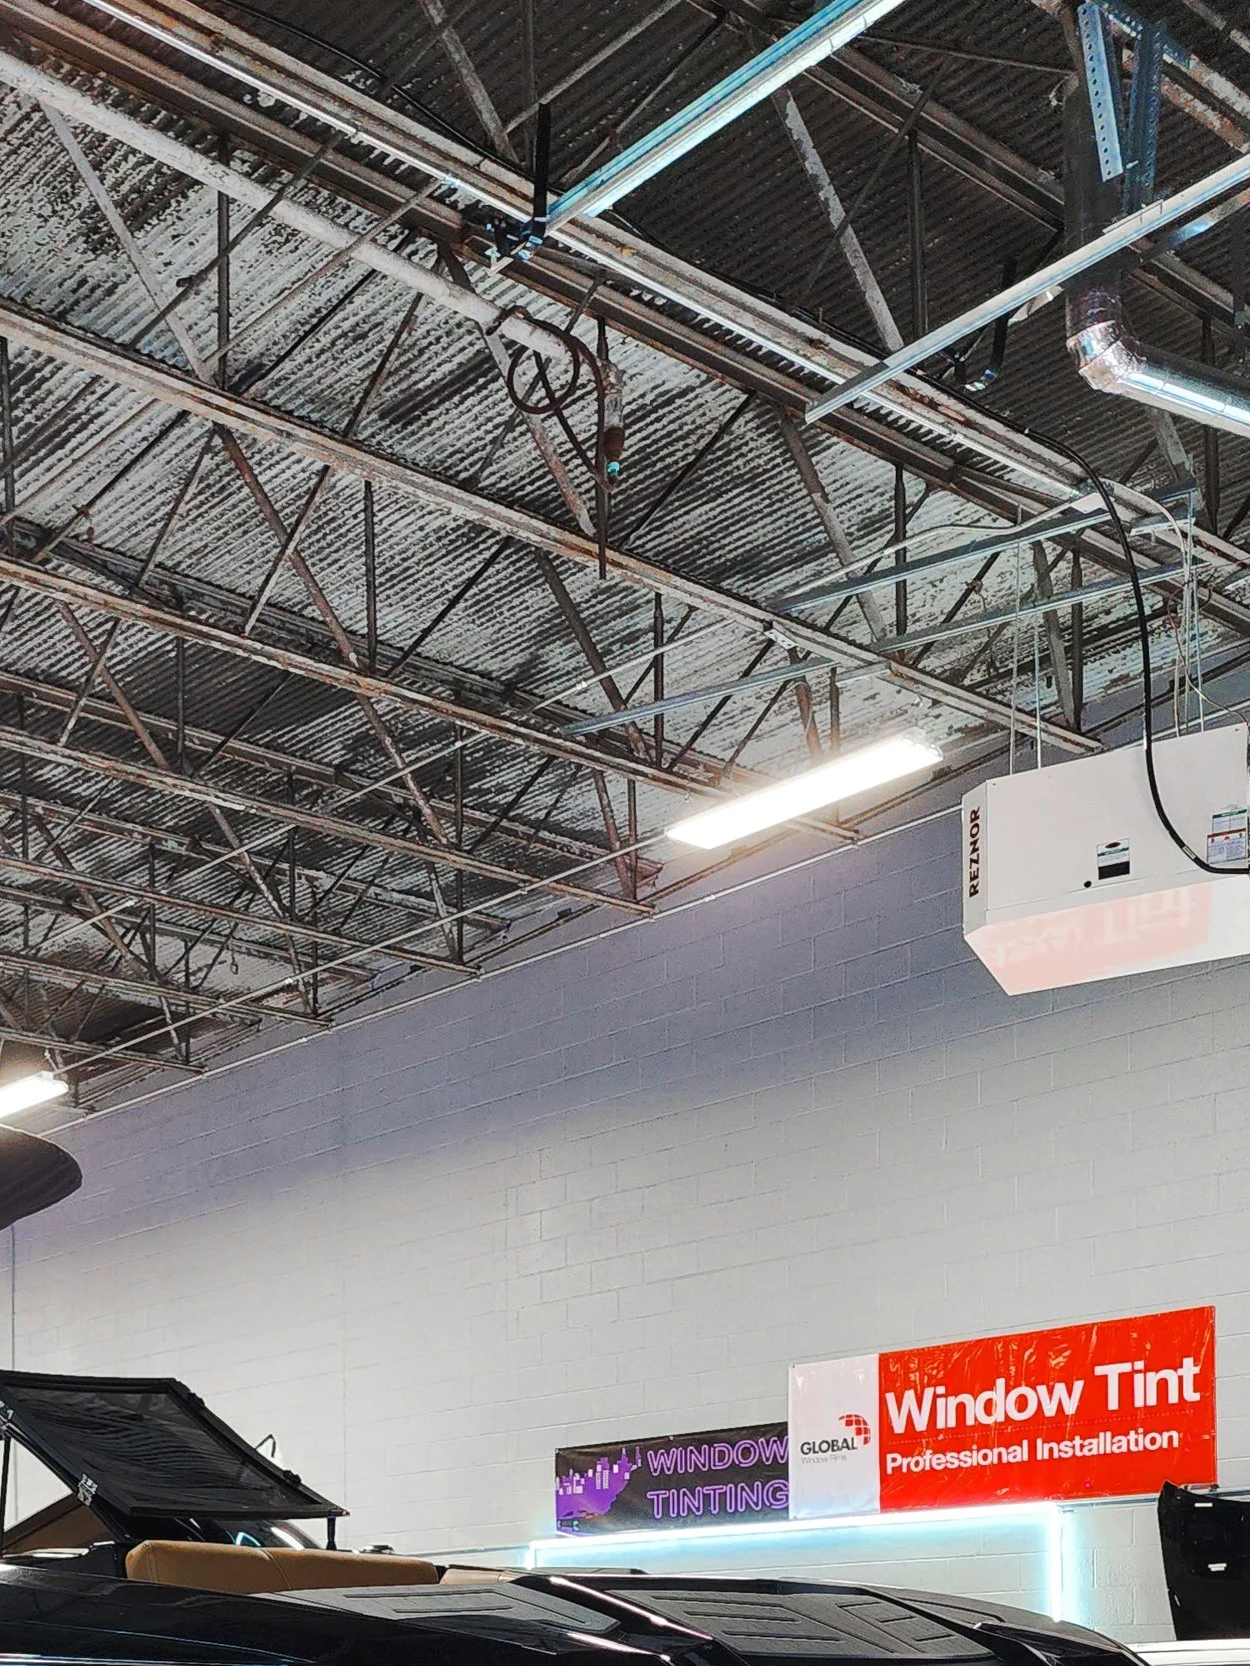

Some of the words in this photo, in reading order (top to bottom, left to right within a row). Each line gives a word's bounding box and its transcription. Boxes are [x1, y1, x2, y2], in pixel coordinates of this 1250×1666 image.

[969, 806, 981, 898] REZNOR
[885, 1378, 1084, 1435] Window
[1095, 1357, 1200, 1412] Tint
[647, 1435, 789, 1476] WINDOW
[800, 1437, 858, 1456] GLOBAL
[886, 1440, 1029, 1475] Professional
[1036, 1427, 1179, 1461] Installation
[647, 1479, 789, 1519] TINTING
